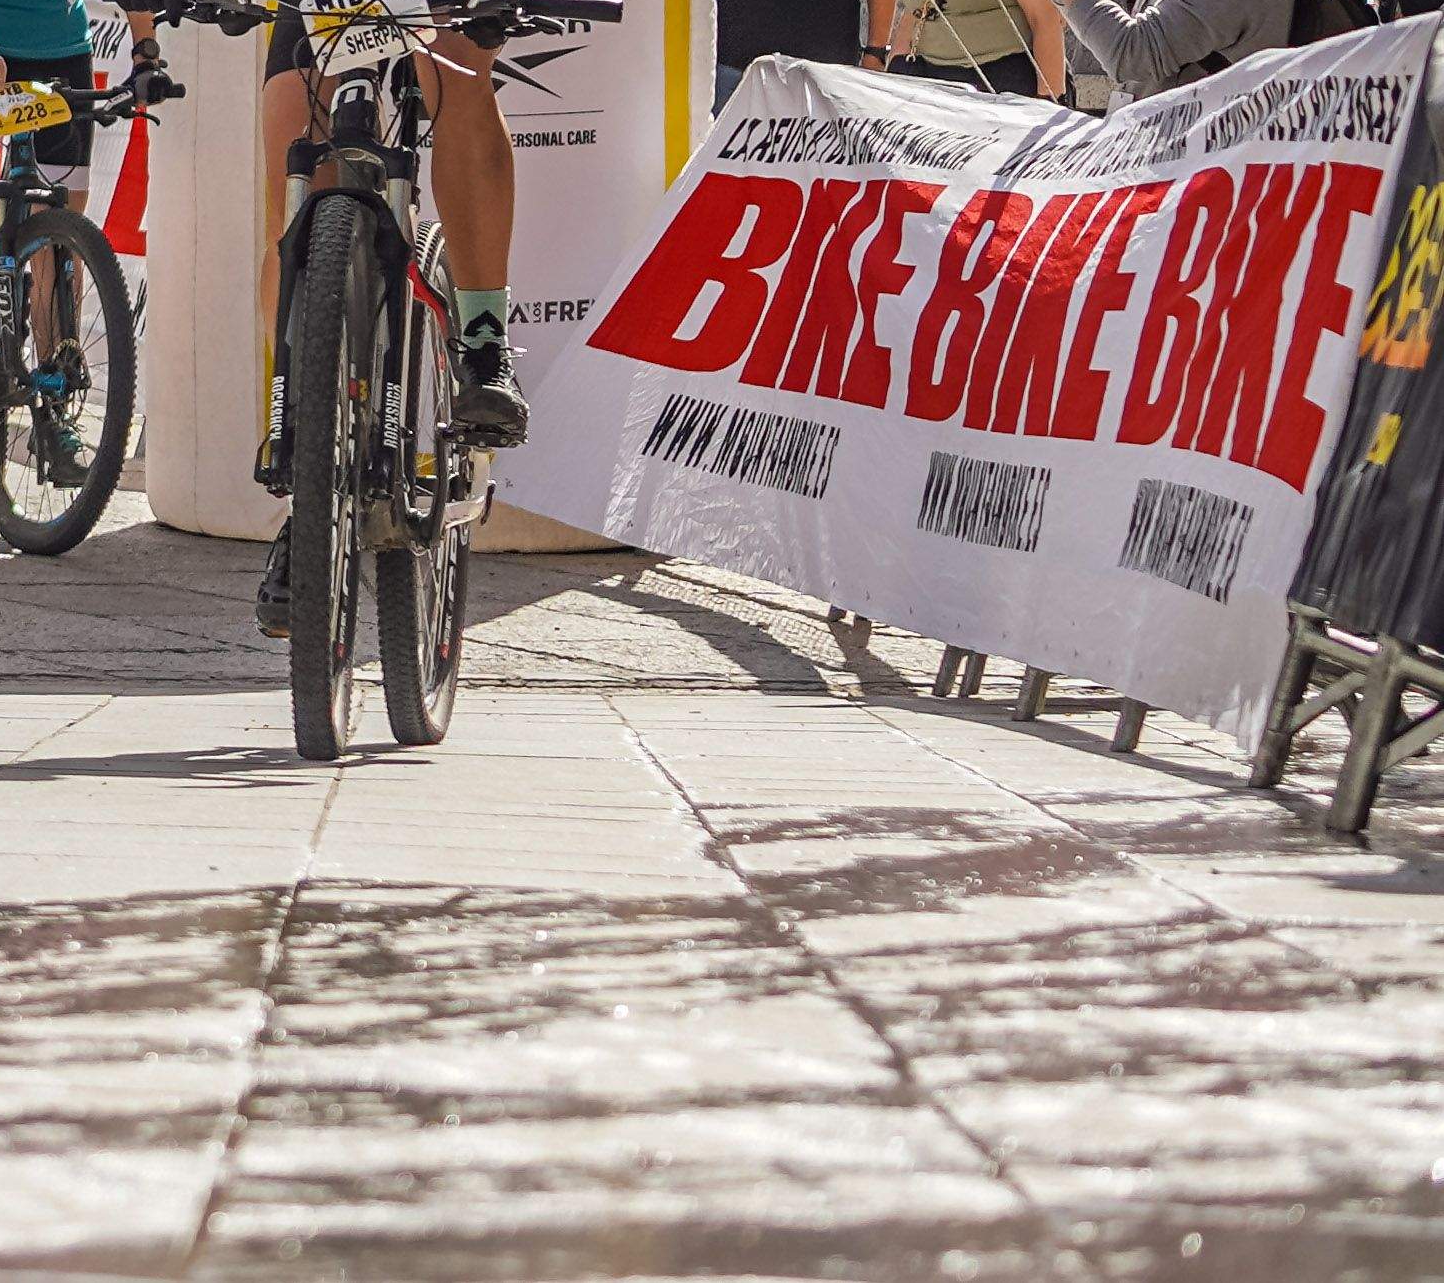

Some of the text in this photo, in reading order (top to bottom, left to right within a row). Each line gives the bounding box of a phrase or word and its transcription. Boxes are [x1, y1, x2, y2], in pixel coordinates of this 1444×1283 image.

[345, 24, 402, 55] SHERPA
[11, 102, 48, 124] 228
[511, 129, 597, 148] ERSONAL CARE
[587, 172, 950, 410] BIKE
[544, 298, 596, 323] FRE
[905, 178, 1177, 442] BIKE
[1115, 161, 1386, 494] BIKE
